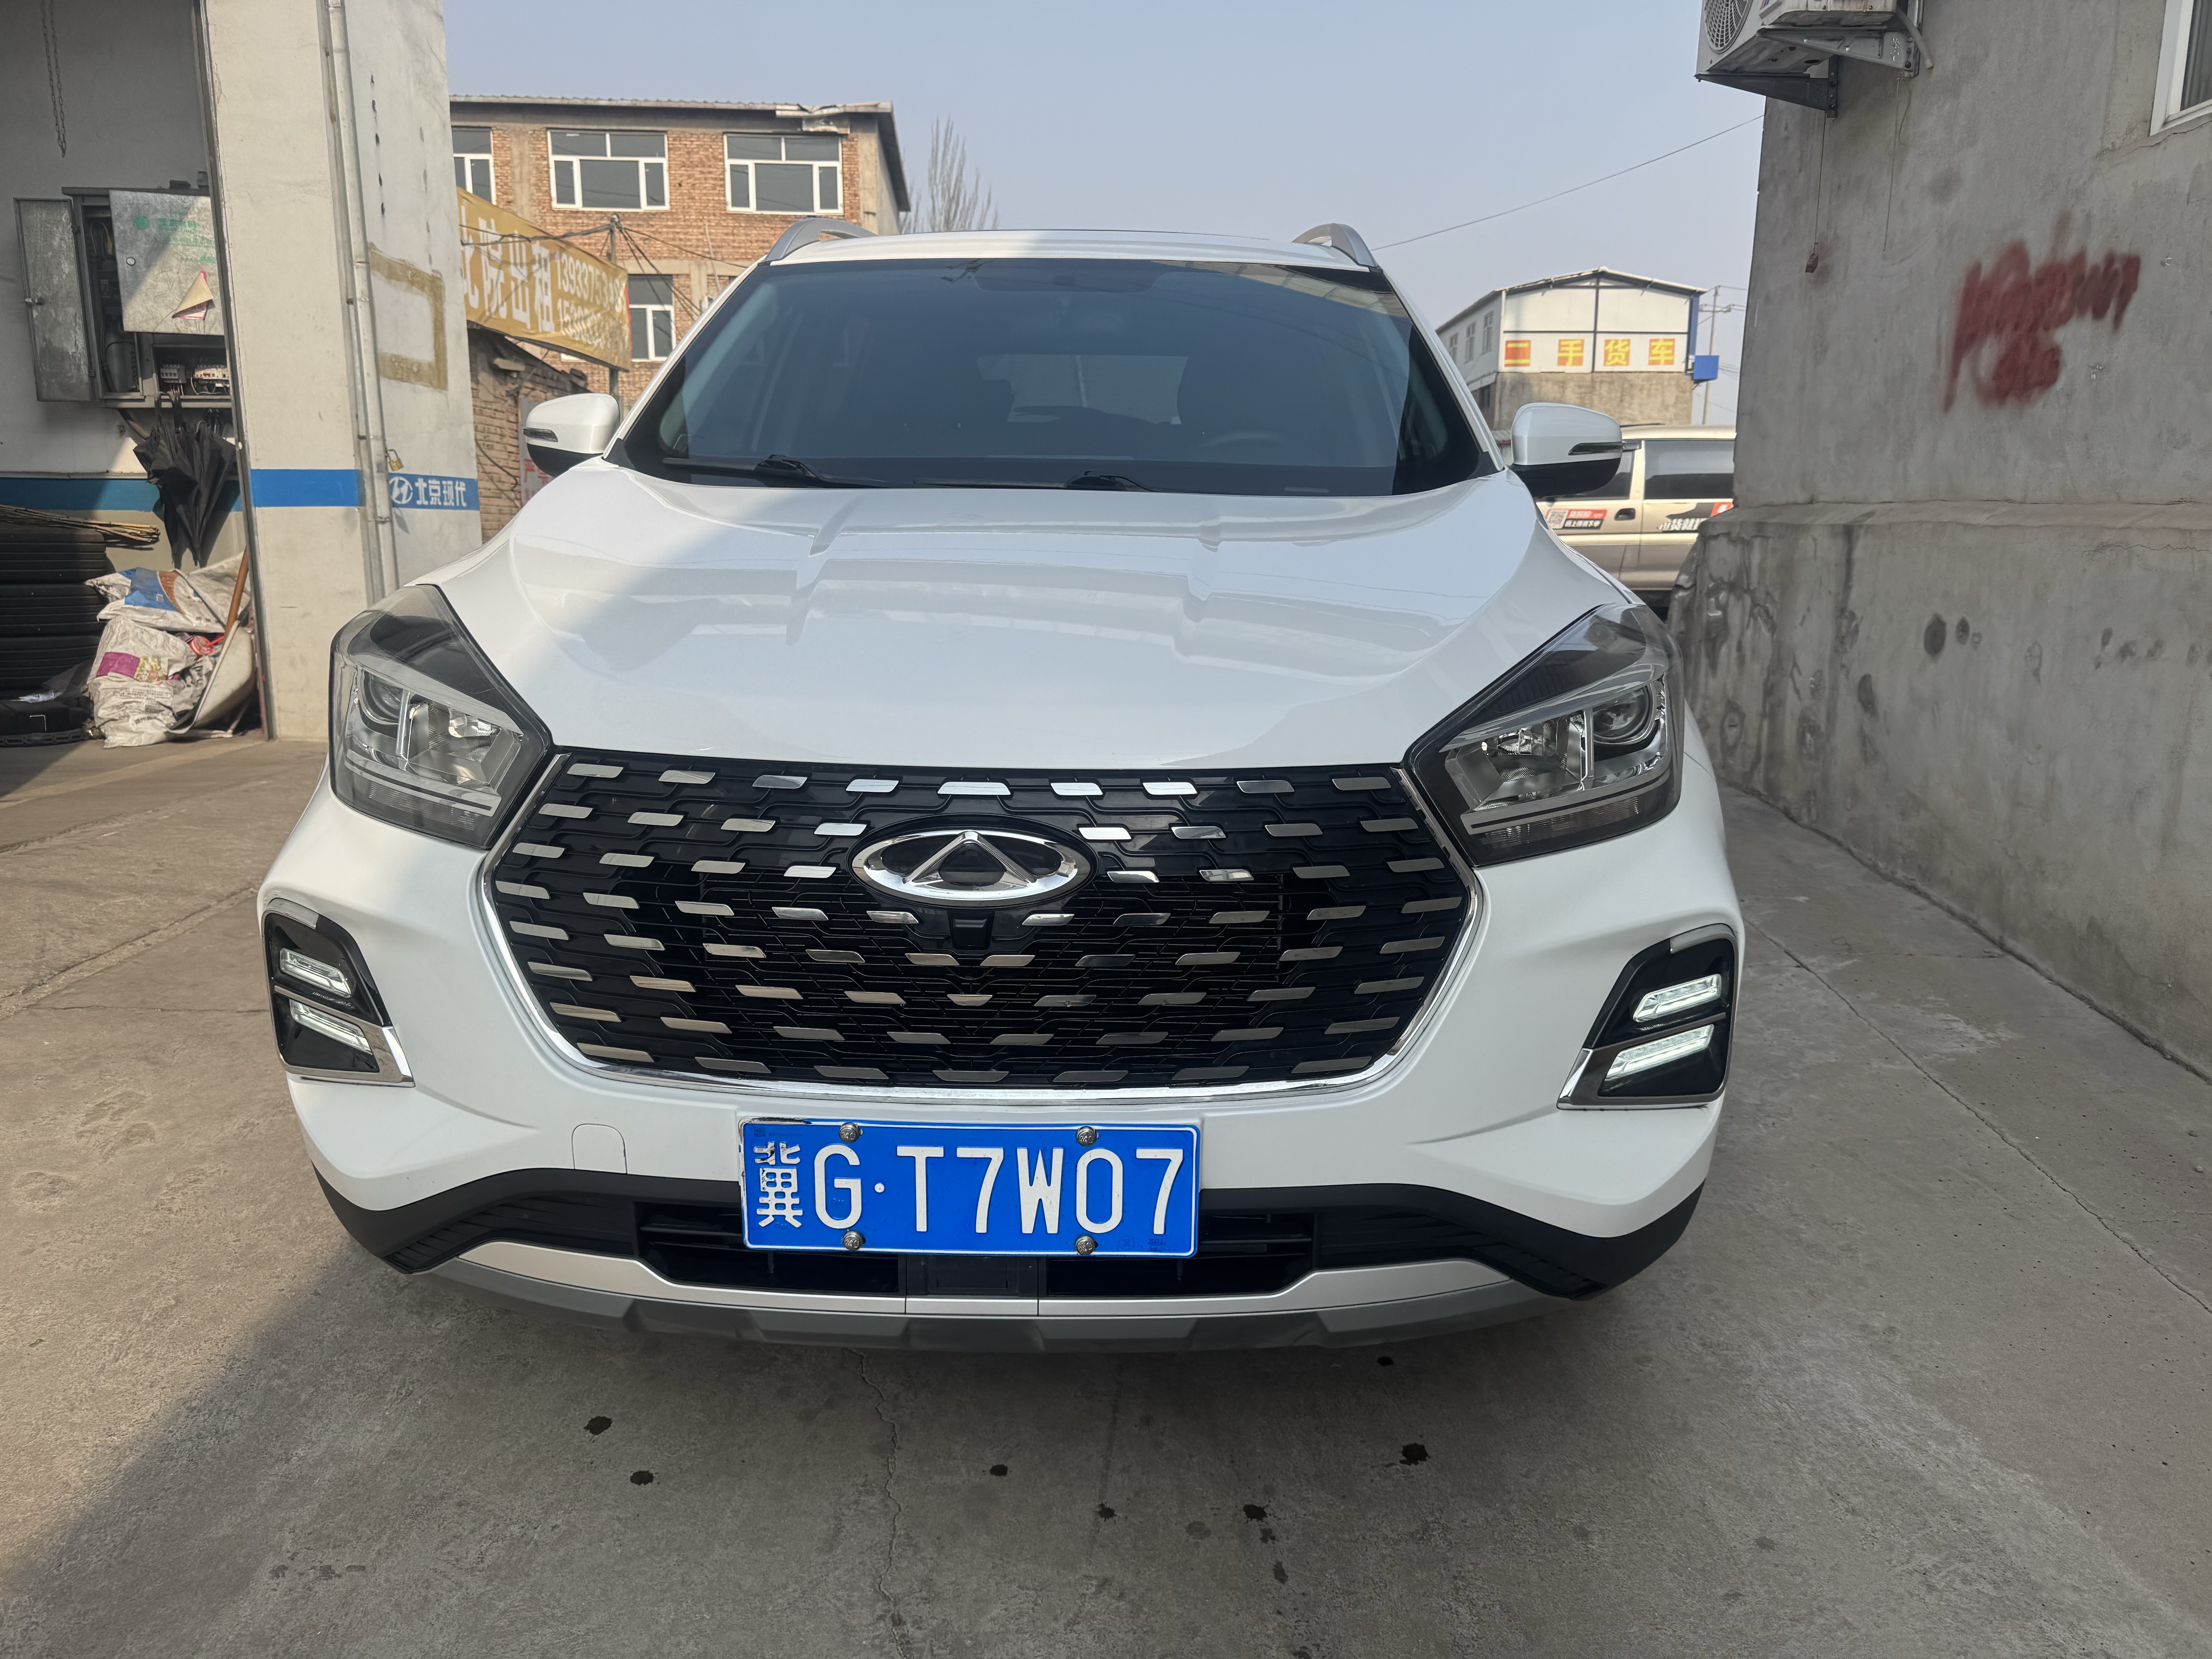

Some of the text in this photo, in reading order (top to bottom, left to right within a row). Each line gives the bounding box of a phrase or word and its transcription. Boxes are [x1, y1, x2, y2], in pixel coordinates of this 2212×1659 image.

[1504, 339, 1674, 366] 二手货车
[415, 477, 467, 507] 北京现代
